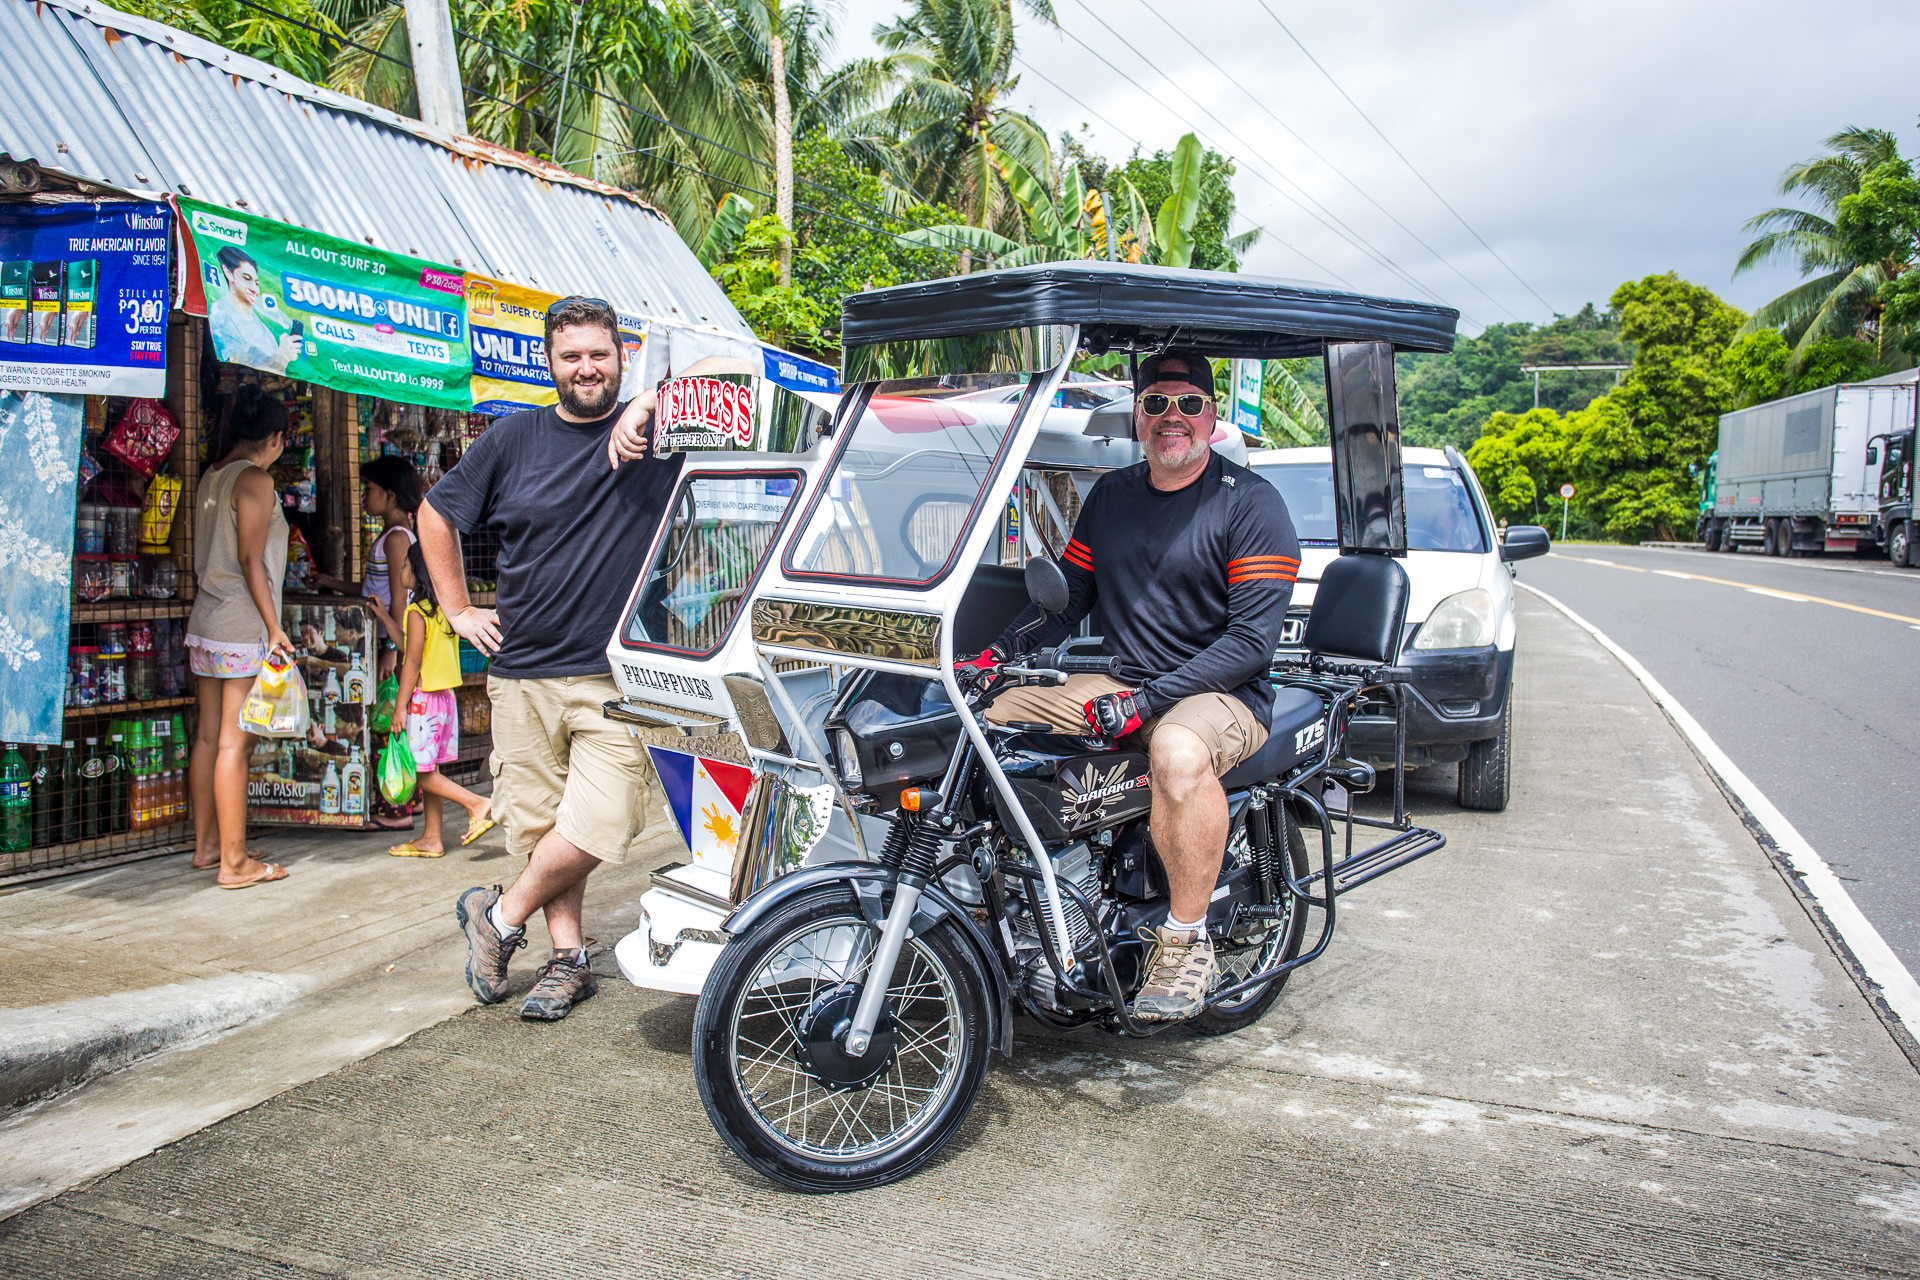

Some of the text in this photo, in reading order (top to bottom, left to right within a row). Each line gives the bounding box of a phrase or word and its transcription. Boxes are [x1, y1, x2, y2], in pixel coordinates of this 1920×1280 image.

[131, 212, 163, 230] Winston
[209, 222, 243, 240] Smart
[69, 238, 166, 252] TRUE AMERICAN FLAVOR
[133, 254, 166, 265] SINCE 1954
[286, 241, 386, 275] ALL OUT SURF 30
[5, 286, 23, 296] Winston
[39, 288, 58, 300] Winston
[69, 289, 90, 300] Winston
[119, 288, 163, 298] STILL AT
[286, 277, 375, 318] 300MB
[388, 299, 441, 333] UNLI
[467, 288, 498, 309] TNT
[500, 302, 530, 318] SUPER
[140, 326, 162, 335] PER STICK
[131, 341, 162, 351] STAY TRUE
[315, 321, 355, 341] CALLS
[407, 340, 444, 358] TEXTS
[472, 330, 528, 365] UNLI
[130, 351, 161, 361] STAY FREE
[481, 360, 492, 371] TO
[41, 367, 77, 377] CIGARETTE
[78, 369, 111, 379] SMOKING
[331, 359, 352, 374] Text
[353, 364, 406, 383] ALLOUT30
[409, 375, 419, 386] to
[420, 376, 444, 390] 9999
[32, 376, 41, 385] TO
[42, 377, 60, 386] YOUR
[61, 379, 87, 387] HEALTH
[670, 435, 687, 446] THE
[689, 433, 726, 446] FRONT
[622, 663, 714, 701] PHILIPPINES
[1294, 717, 1325, 750] 175
[273, 782, 306, 798] PASKO
[1077, 779, 1134, 805] BARAKO
[289, 797, 305, 807] Miguel
